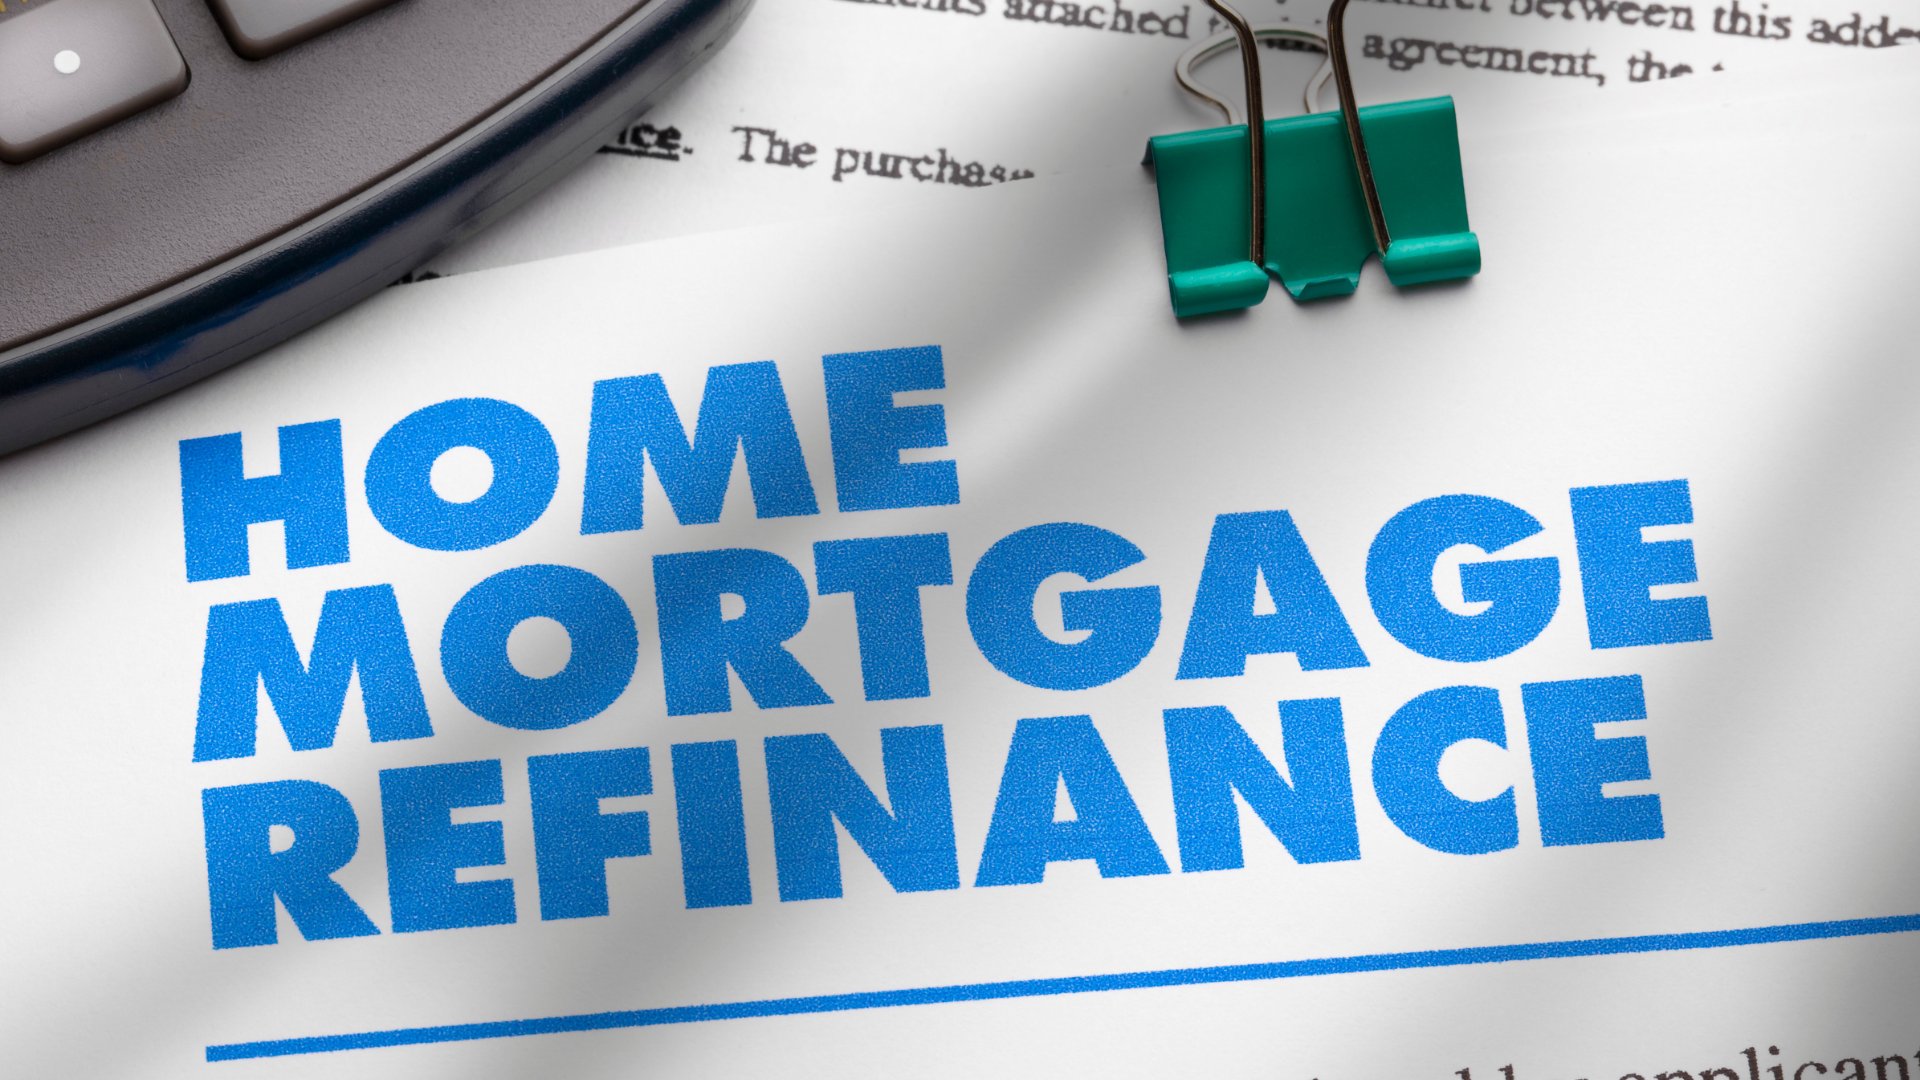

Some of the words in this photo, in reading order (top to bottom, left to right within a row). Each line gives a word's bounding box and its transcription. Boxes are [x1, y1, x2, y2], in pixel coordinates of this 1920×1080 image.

[1003, 0, 1190, 39] attached
[1712, 0, 1792, 40] this
[1806, 13, 1920, 48] adde
[1362, 34, 1606, 87] agreement,
[731, 125, 818, 168] The
[179, 345, 960, 583] HOME
[192, 479, 1712, 763] MORTGAGE
[201, 674, 1665, 950] REFINANCE
[1618, 1046, 1920, 1080] lican
